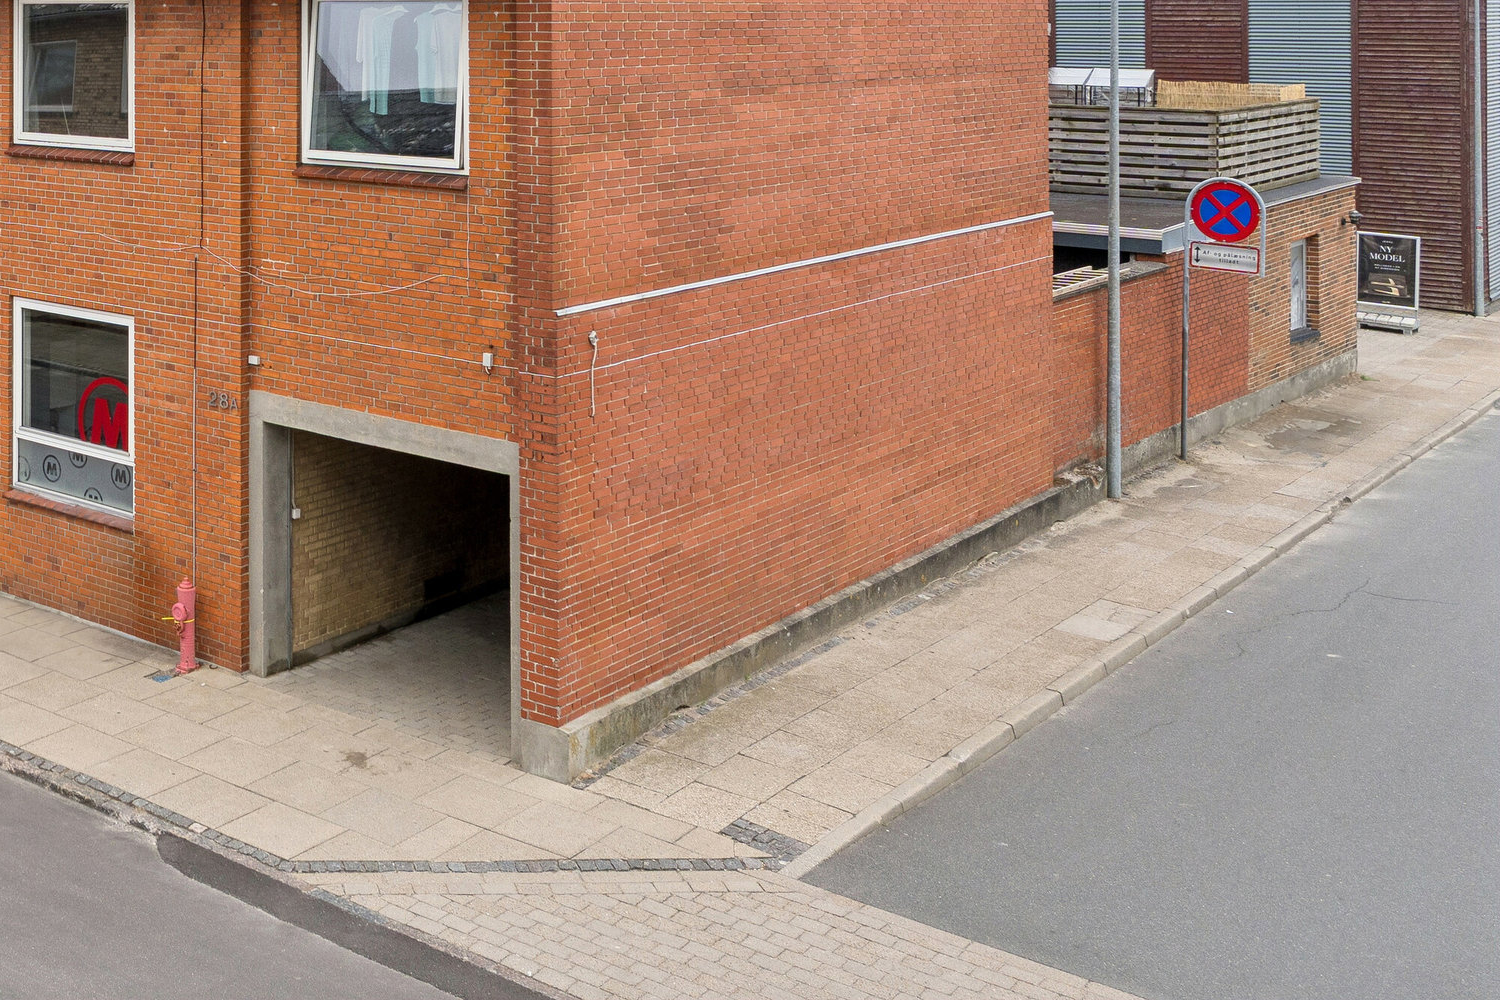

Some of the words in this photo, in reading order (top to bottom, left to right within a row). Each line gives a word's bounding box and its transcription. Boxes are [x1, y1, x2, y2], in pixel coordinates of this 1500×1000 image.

[1380, 245, 1393, 253] NY
[1223, 252, 1256, 261] pålæsning
[1370, 252, 1406, 263] MODEL
[209, 390, 238, 409] 28A
[90, 397, 129, 452] M
